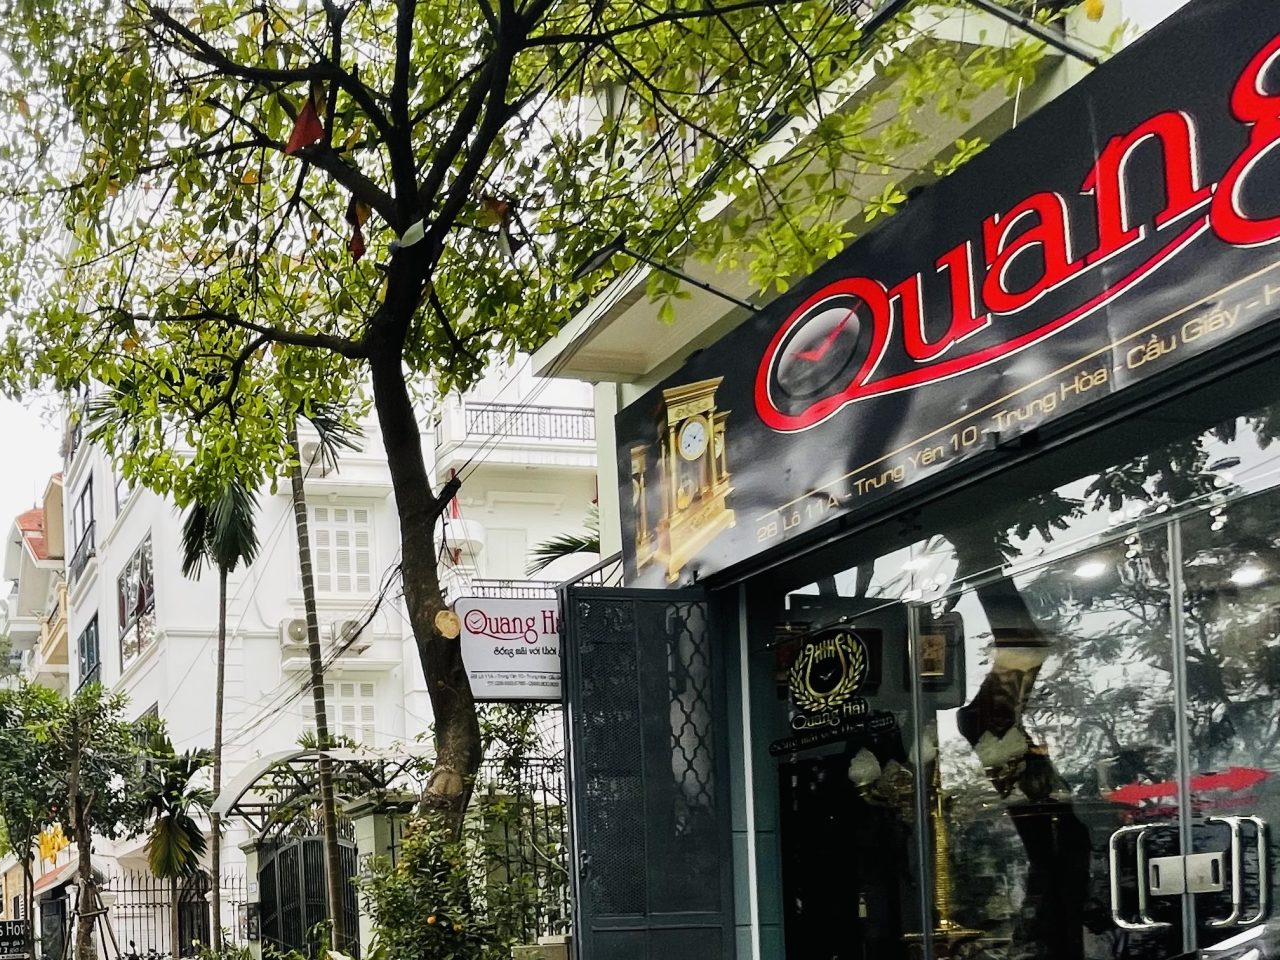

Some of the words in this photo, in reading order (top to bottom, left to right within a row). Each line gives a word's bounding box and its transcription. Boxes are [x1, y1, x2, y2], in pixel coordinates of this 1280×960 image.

[805, 496, 840, 519] 11A
[853, 464, 904, 496] Trung
[908, 449, 944, 468] Yên
[950, 425, 978, 450] 10
[992, 390, 1057, 427] Trung
[1061, 367, 1108, 401] Hòa
[1126, 333, 1177, 369] Cầu
[1181, 300, 1241, 343] Giấy
[464, 609, 538, 645] Quang
